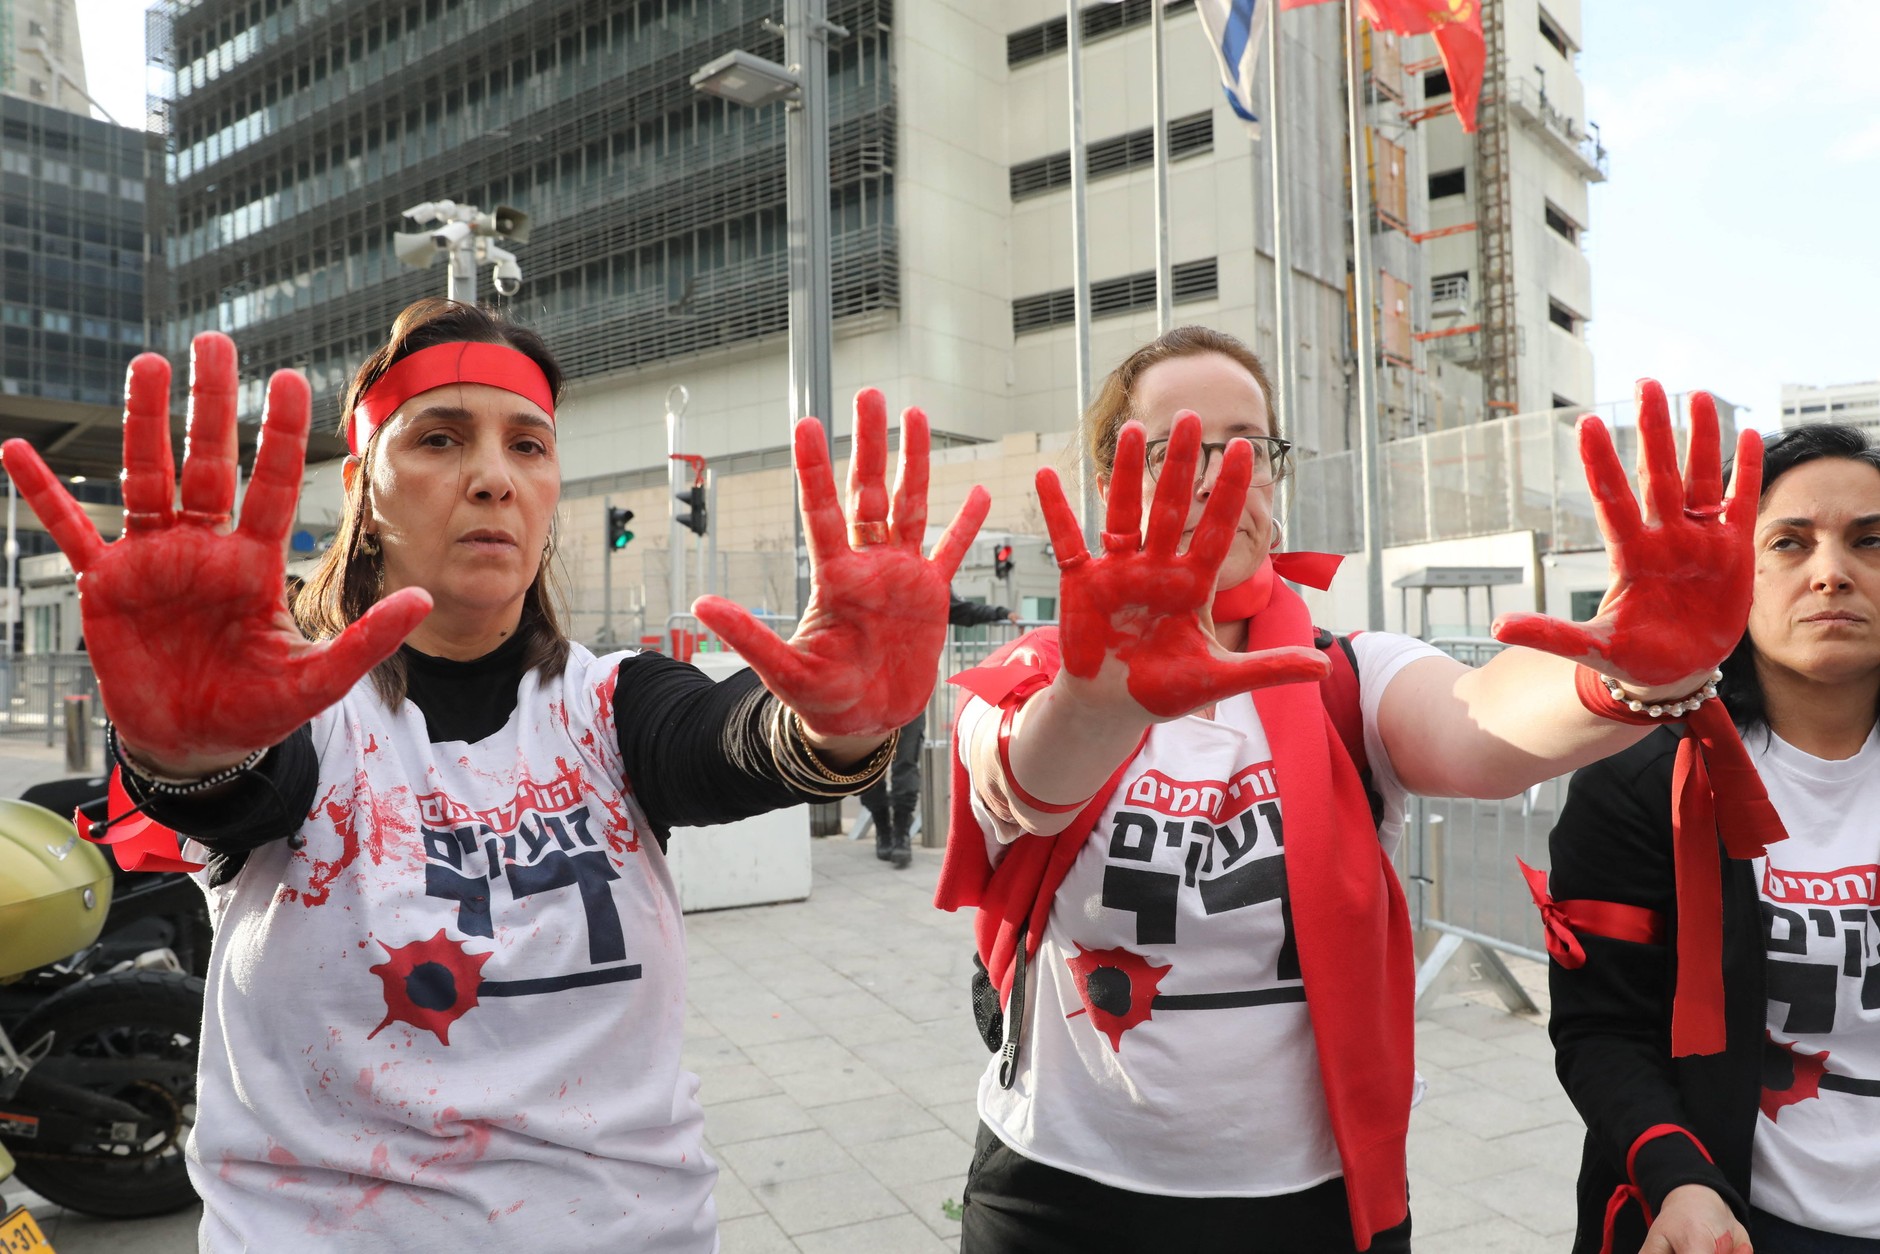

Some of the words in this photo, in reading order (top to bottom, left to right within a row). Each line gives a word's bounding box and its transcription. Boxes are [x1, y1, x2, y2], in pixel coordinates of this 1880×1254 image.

[517, 780, 574, 809] הורי
[1131, 776, 1226, 819] חמים
[1228, 767, 1277, 800] ורי
[421, 806, 598, 880] זועקים
[1109, 801, 1285, 888] ועקים
[425, 850, 627, 965] די
[1768, 867, 1877, 900] וחמים
[1760, 901, 1880, 977] קים
